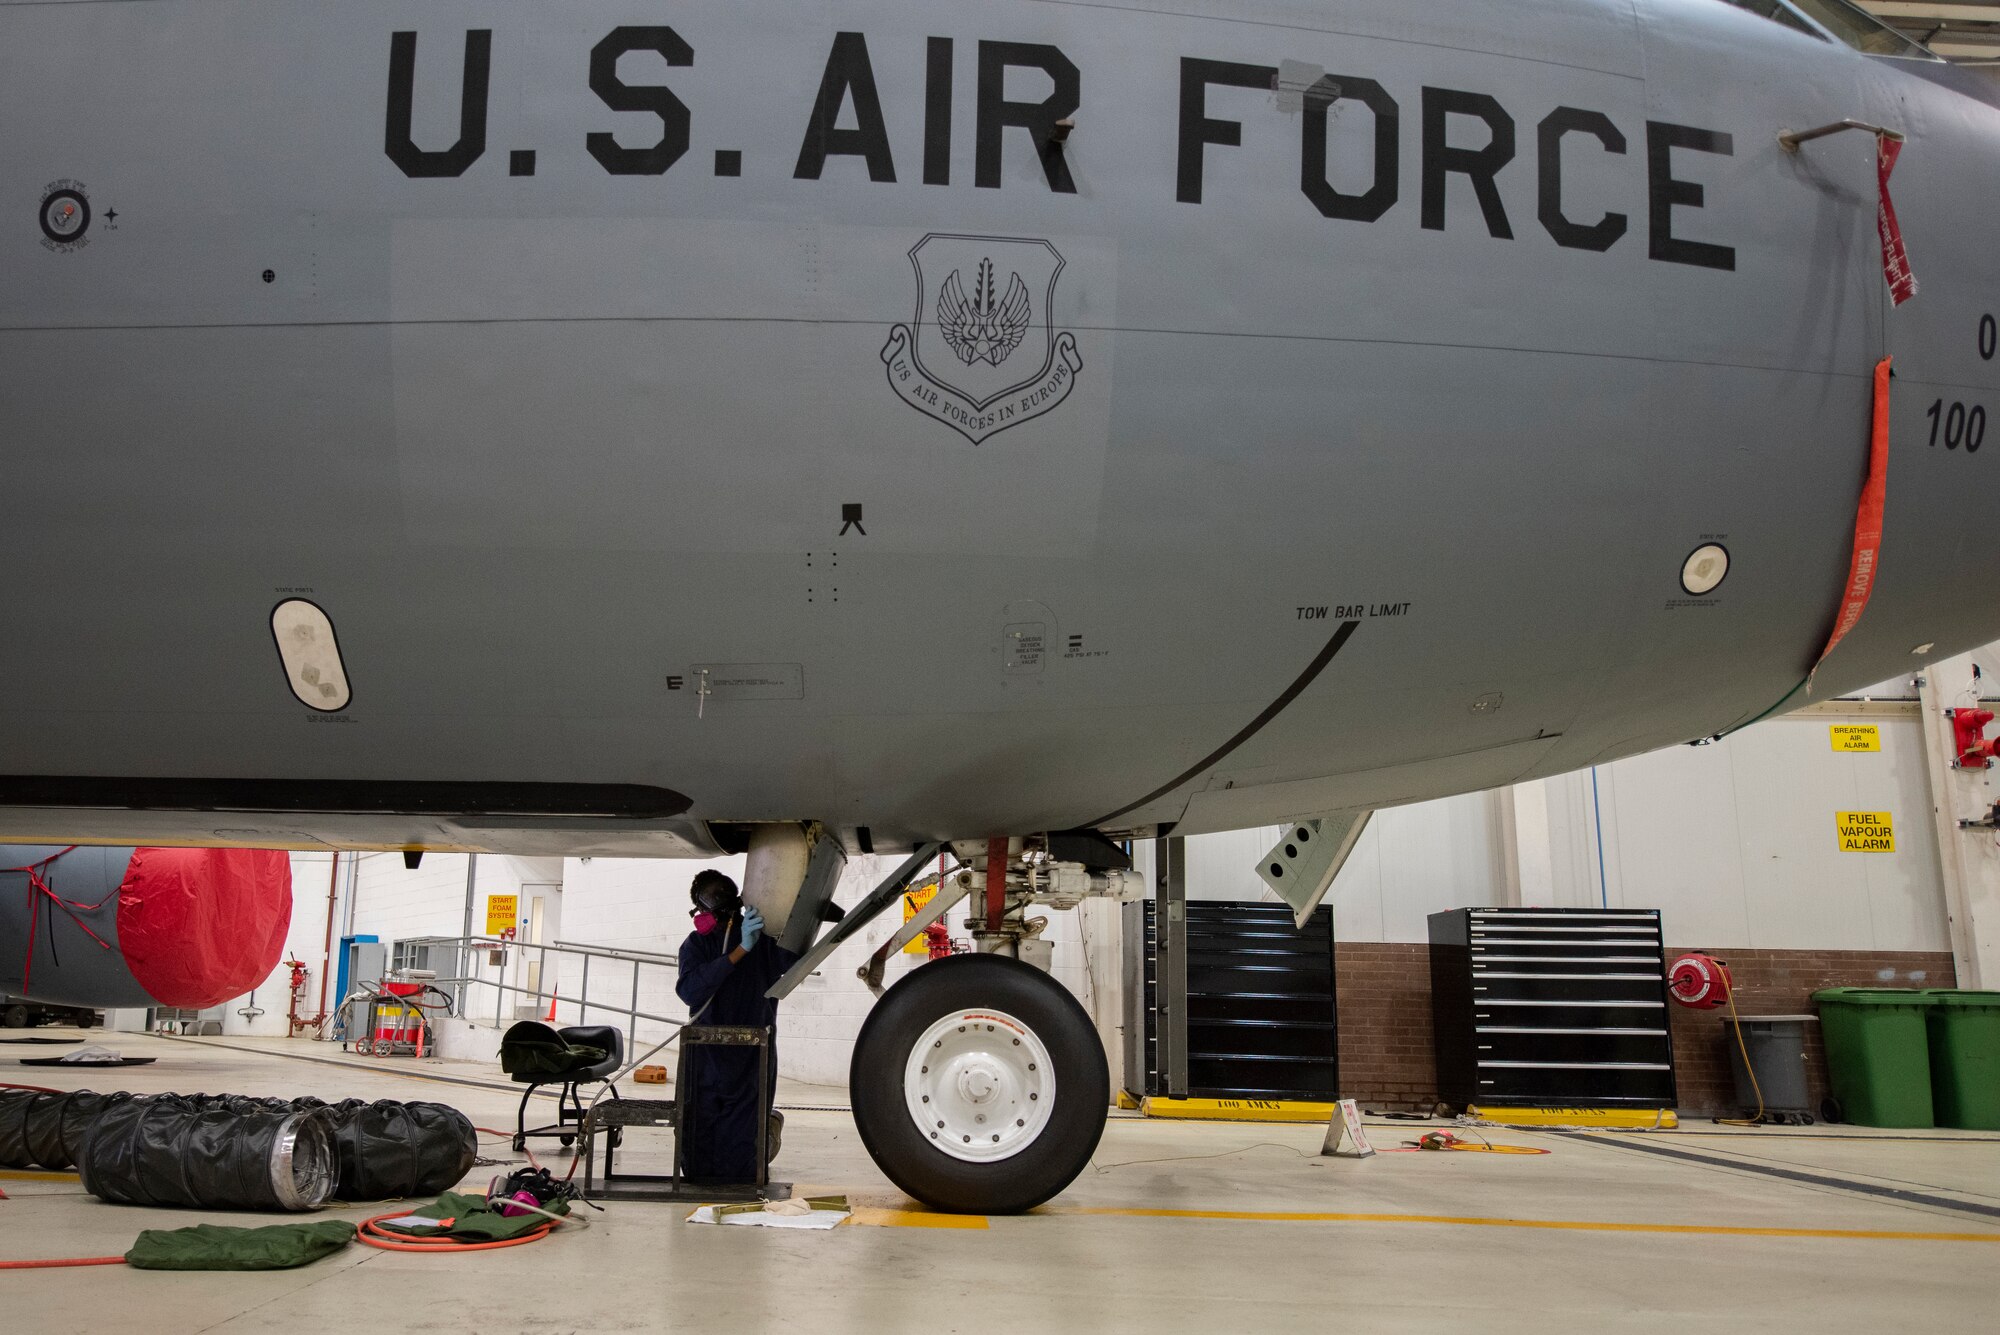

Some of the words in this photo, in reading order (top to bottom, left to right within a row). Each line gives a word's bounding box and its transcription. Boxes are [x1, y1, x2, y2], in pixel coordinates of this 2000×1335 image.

[385, 26, 742, 178] U.S.
[793, 31, 1081, 194] AIR
[1175, 56, 1736, 272] FORCE
[1978, 313, 1997, 361] 0
[893, 359, 911, 382] US
[912, 384, 939, 406] AIR
[942, 401, 995, 430] FORCES
[999, 404, 1015, 421] IN
[1021, 363, 1068, 412] EUROPE
[1927, 398, 1987, 453] 100
[1851, 549, 1874, 597] REMOVE
[1296, 606, 1329, 620] TOW
[1335, 605, 1364, 619] BAR
[1369, 602, 1411, 617] LIMIT
[1848, 814, 1881, 825] FUEL
[1840, 826, 1892, 837] VAPOUR
[1845, 839, 1891, 850] ALARM
[908, 888, 932, 899] START
[1218, 1100, 1240, 1109] 100
